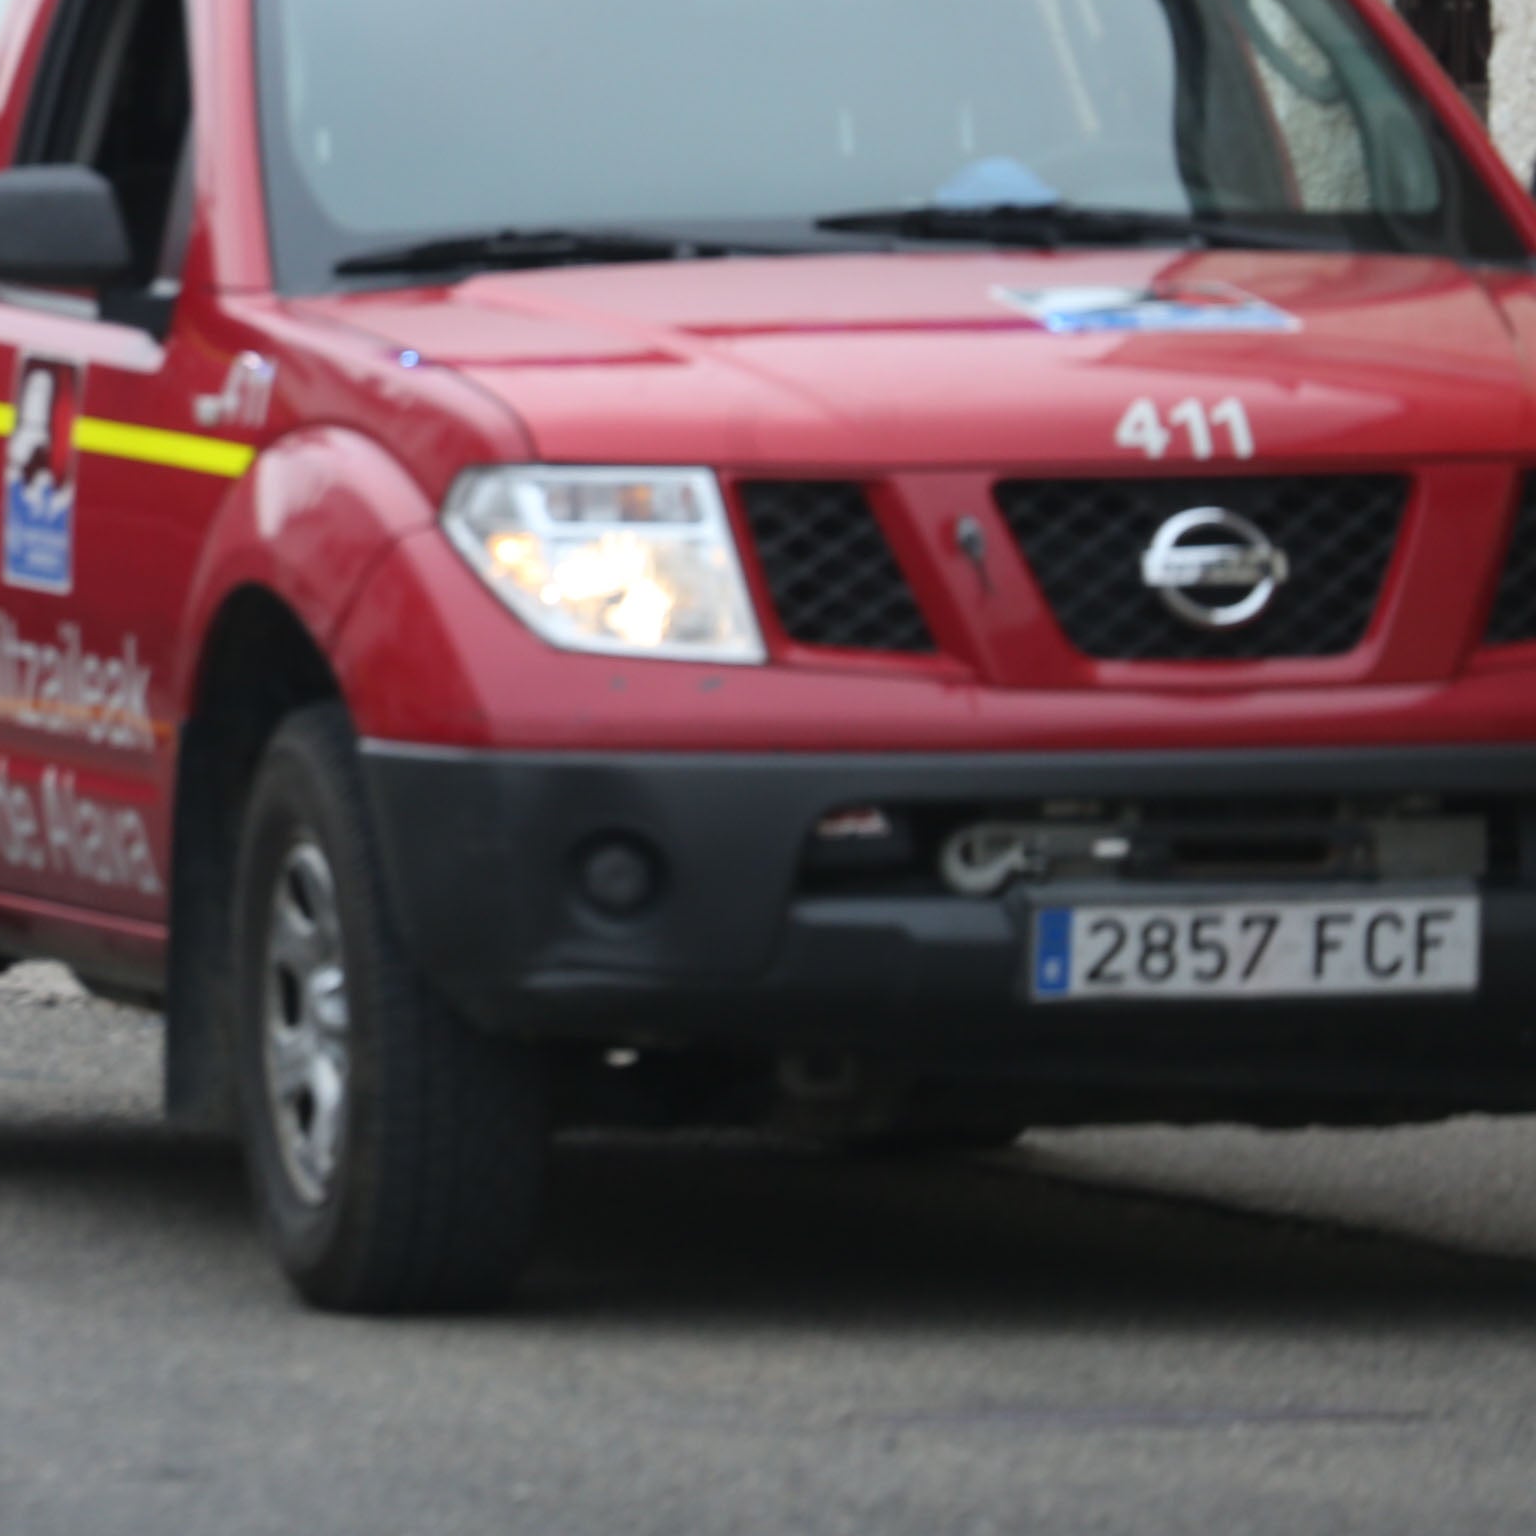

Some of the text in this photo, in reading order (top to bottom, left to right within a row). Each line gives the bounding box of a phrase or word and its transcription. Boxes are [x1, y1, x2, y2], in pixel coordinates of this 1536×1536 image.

[1114, 396, 1256, 461] 411
[1084, 907, 1457, 985] 2857 FCF
